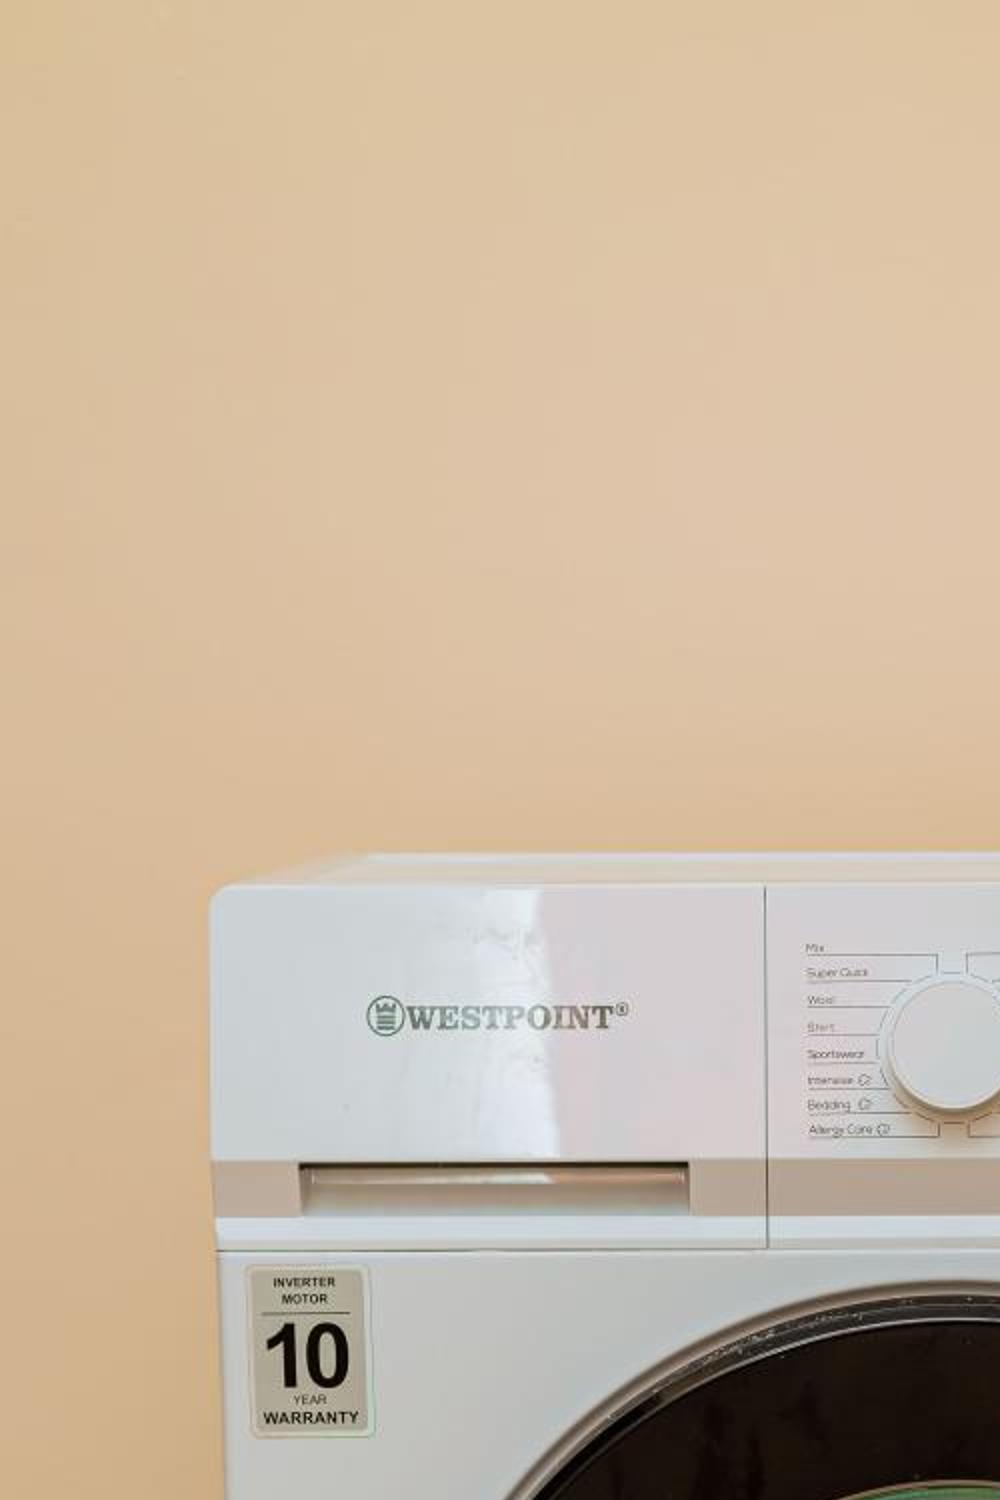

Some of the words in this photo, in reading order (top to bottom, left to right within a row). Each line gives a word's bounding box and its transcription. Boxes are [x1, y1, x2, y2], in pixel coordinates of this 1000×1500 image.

[807, 967, 839, 979] Super
[807, 1099, 850, 1113] Bedding
[809, 1124, 844, 1138] Allergy
[847, 1123, 873, 1134] Care
[273, 1277, 336, 1287] INVERTER
[281, 1293, 328, 1304] MOTOR
[266, 1322, 349, 1389] 10
[294, 1394, 327, 1405] YEAR
[263, 1411, 359, 1424] WARRANTY
